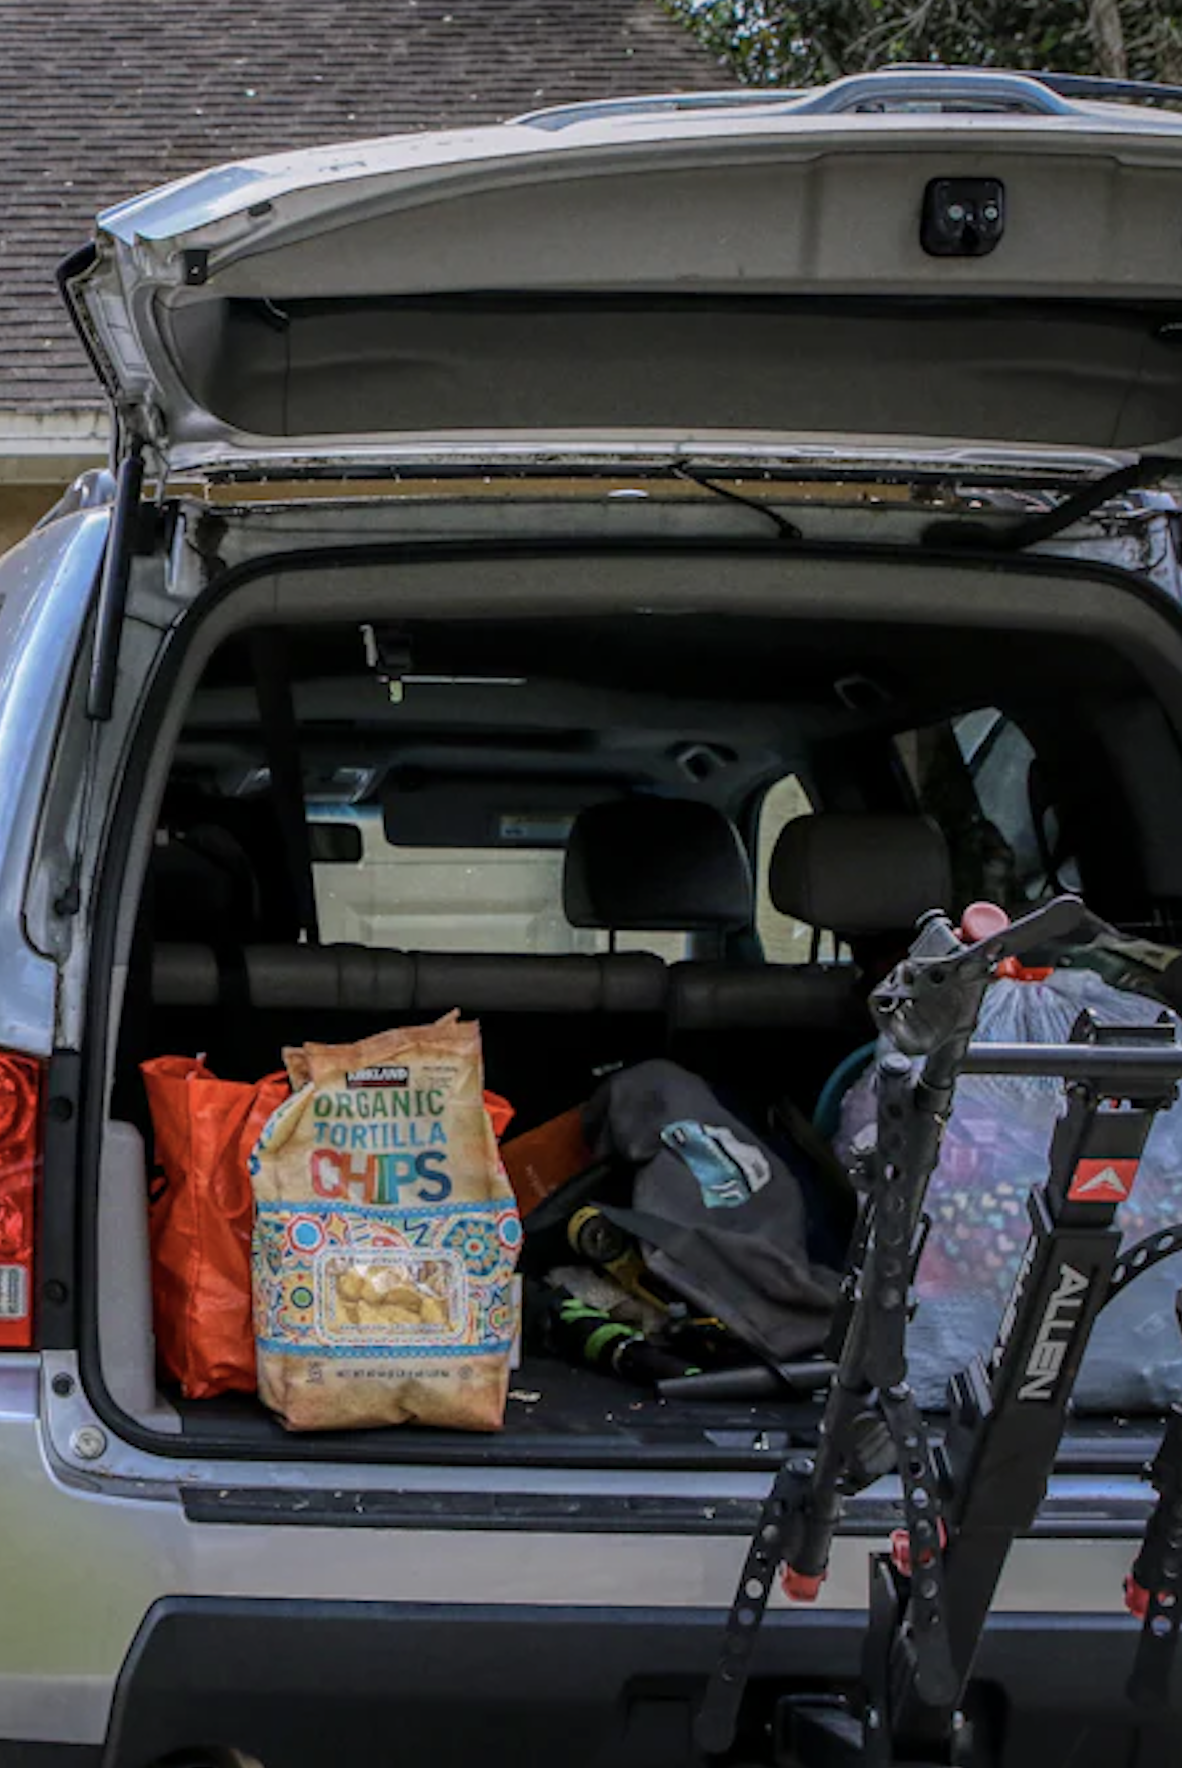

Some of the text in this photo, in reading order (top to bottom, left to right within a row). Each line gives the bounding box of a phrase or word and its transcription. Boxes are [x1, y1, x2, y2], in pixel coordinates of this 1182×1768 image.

[313, 1089, 444, 1117] ORGANIC
[313, 1121, 447, 1148] TORTILLA
[310, 1148, 452, 1205] CHIPS
[1018, 1263, 1090, 1400] ALLEN
